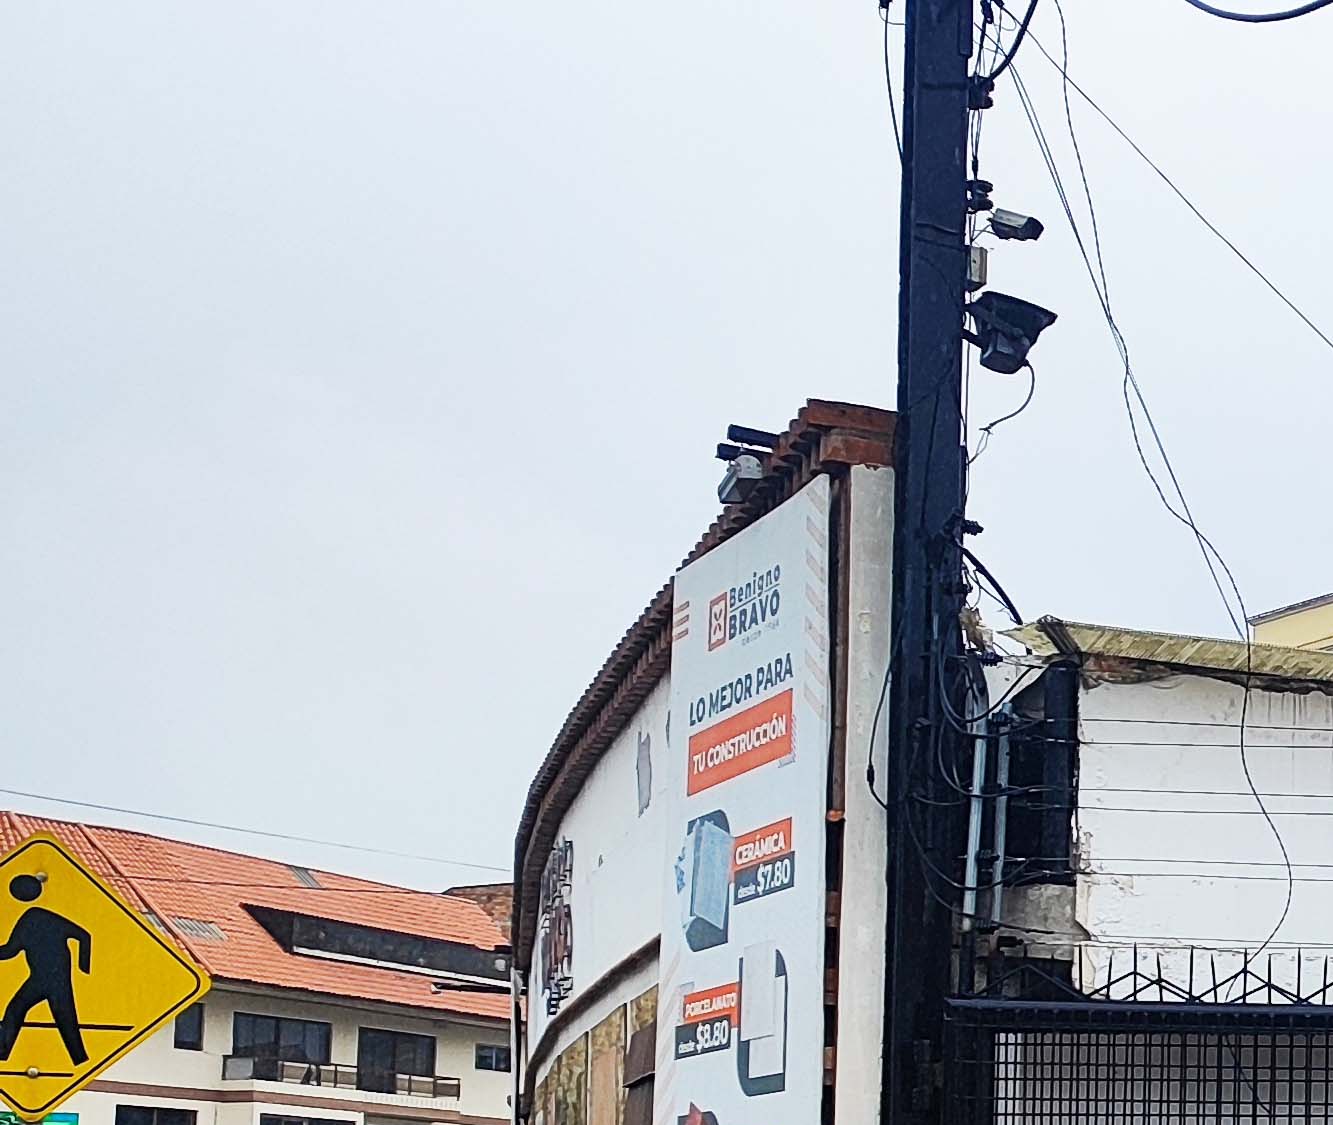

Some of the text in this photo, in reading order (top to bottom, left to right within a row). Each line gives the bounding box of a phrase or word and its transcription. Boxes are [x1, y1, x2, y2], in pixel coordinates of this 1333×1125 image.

[729, 564, 781, 609] Benigno
[729, 589, 780, 640] BRAVO
[690, 653, 793, 726] LO MEJOR PARA
[693, 713, 786, 775] TU CONSTRUCCIÓN
[757, 859, 790, 895] $7.80
[697, 1020, 728, 1053] $8.80
